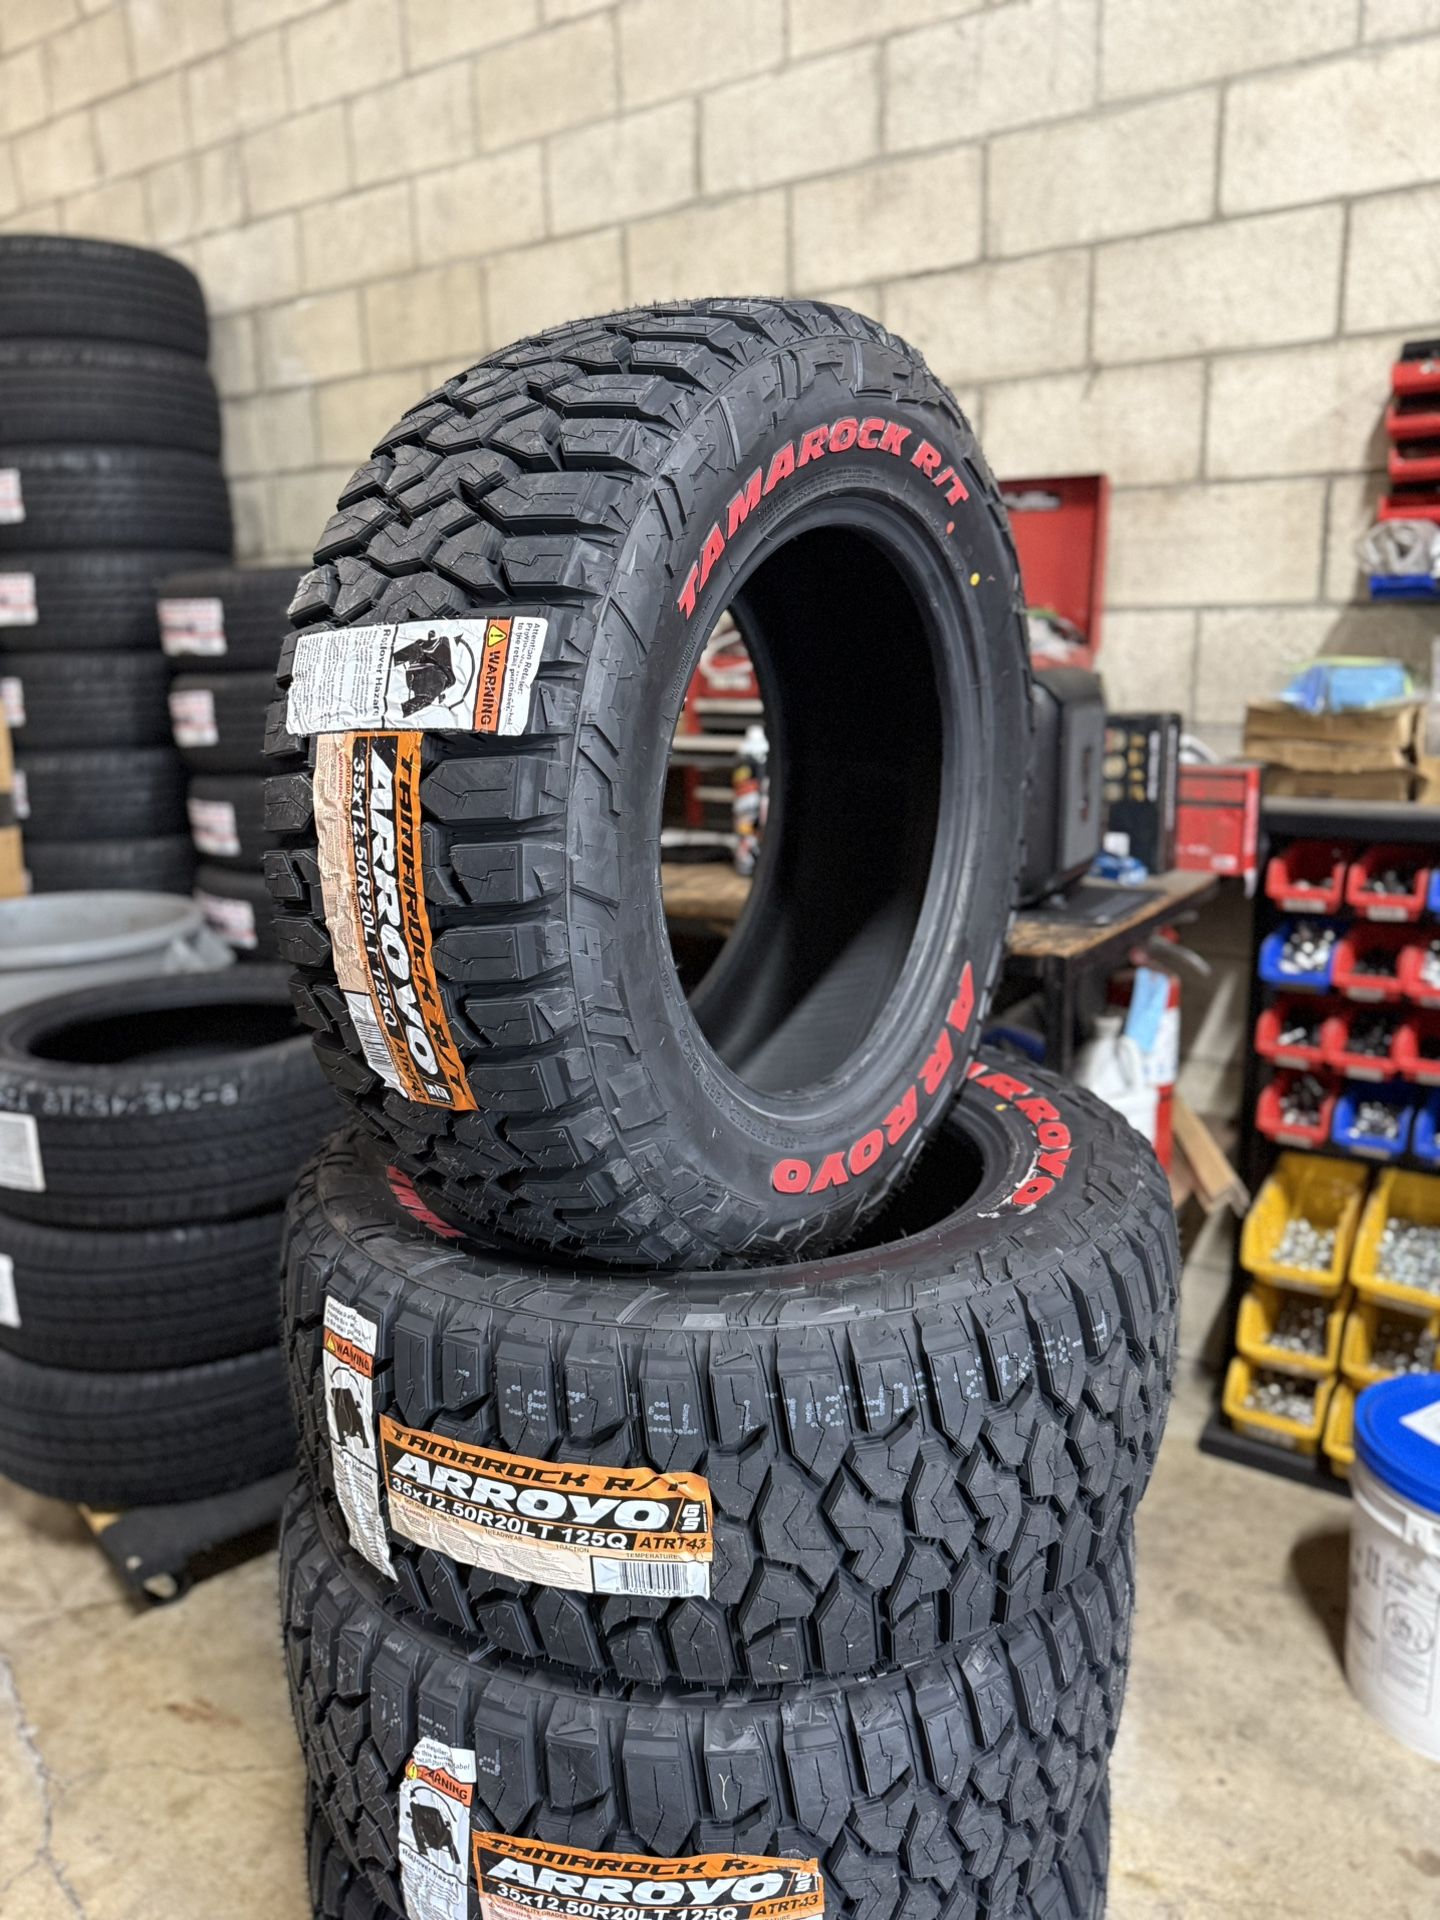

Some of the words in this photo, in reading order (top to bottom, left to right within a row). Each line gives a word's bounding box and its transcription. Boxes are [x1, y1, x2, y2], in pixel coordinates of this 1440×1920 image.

[677, 416, 911, 620] TAMAROCK
[480, 650, 502, 725] WARNING
[351, 757, 380, 961] 35x12.50R20LT
[373, 968, 398, 1027] 125Q
[371, 748, 439, 1075] ARROYO
[336, 1342, 370, 1371] WANING
[391, 1453, 670, 1530] ARROYO
[393, 1430, 590, 1490] TAMAROCK
[391, 1479, 554, 1539] 35x12.50R20LT
[561, 1527, 628, 1549] 125Q
[639, 1537, 707, 1550] ATRT43
[427, 1771, 468, 1800] ARNING
[486, 1857, 784, 1905] ARROYO
[488, 1838, 704, 1876] TAMAROCK
[497, 1884, 670, 1920] 35x12.50R20LT
[677, 1905, 738, 1920] 125Q
[754, 1895, 818, 1916] ATRT43
